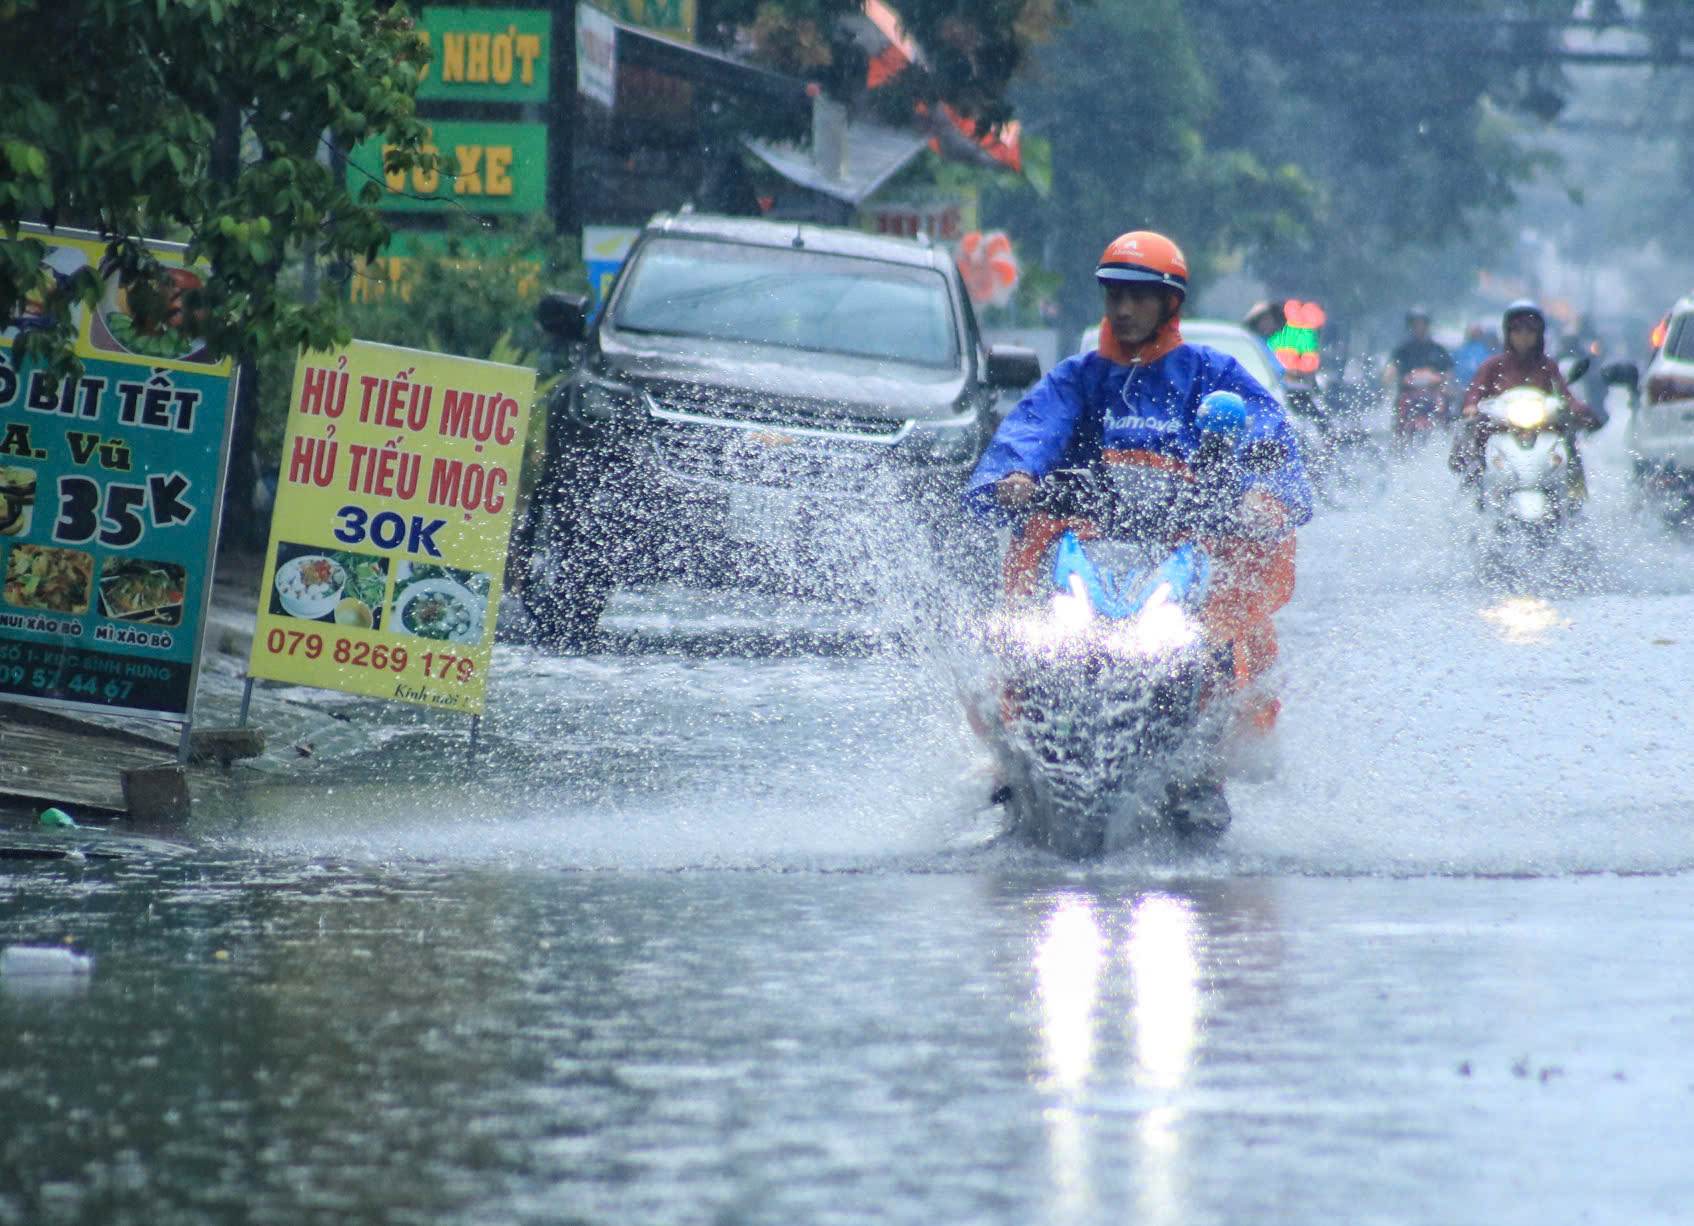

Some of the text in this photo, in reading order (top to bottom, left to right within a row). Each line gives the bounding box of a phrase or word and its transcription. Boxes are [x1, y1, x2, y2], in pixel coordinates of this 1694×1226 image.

[454, 146, 513, 195] XE
[116, 366, 202, 433] TẾT
[300, 355, 519, 453] HỦ TIẾU MỰC
[65, 431, 131, 470] Vũ
[288, 424, 509, 521] HỦ TIẾU MỌC
[52, 471, 196, 549] 35K
[333, 505, 447, 558] 30K
[26, 615, 58, 633] XÀO
[60, 619, 83, 636] BÒ
[95, 622, 173, 649] MÌ XÀO BÒ
[267, 628, 475, 684] 079 8269 179
[68, 675, 97, 695] 44
[104, 679, 134, 701] 67
